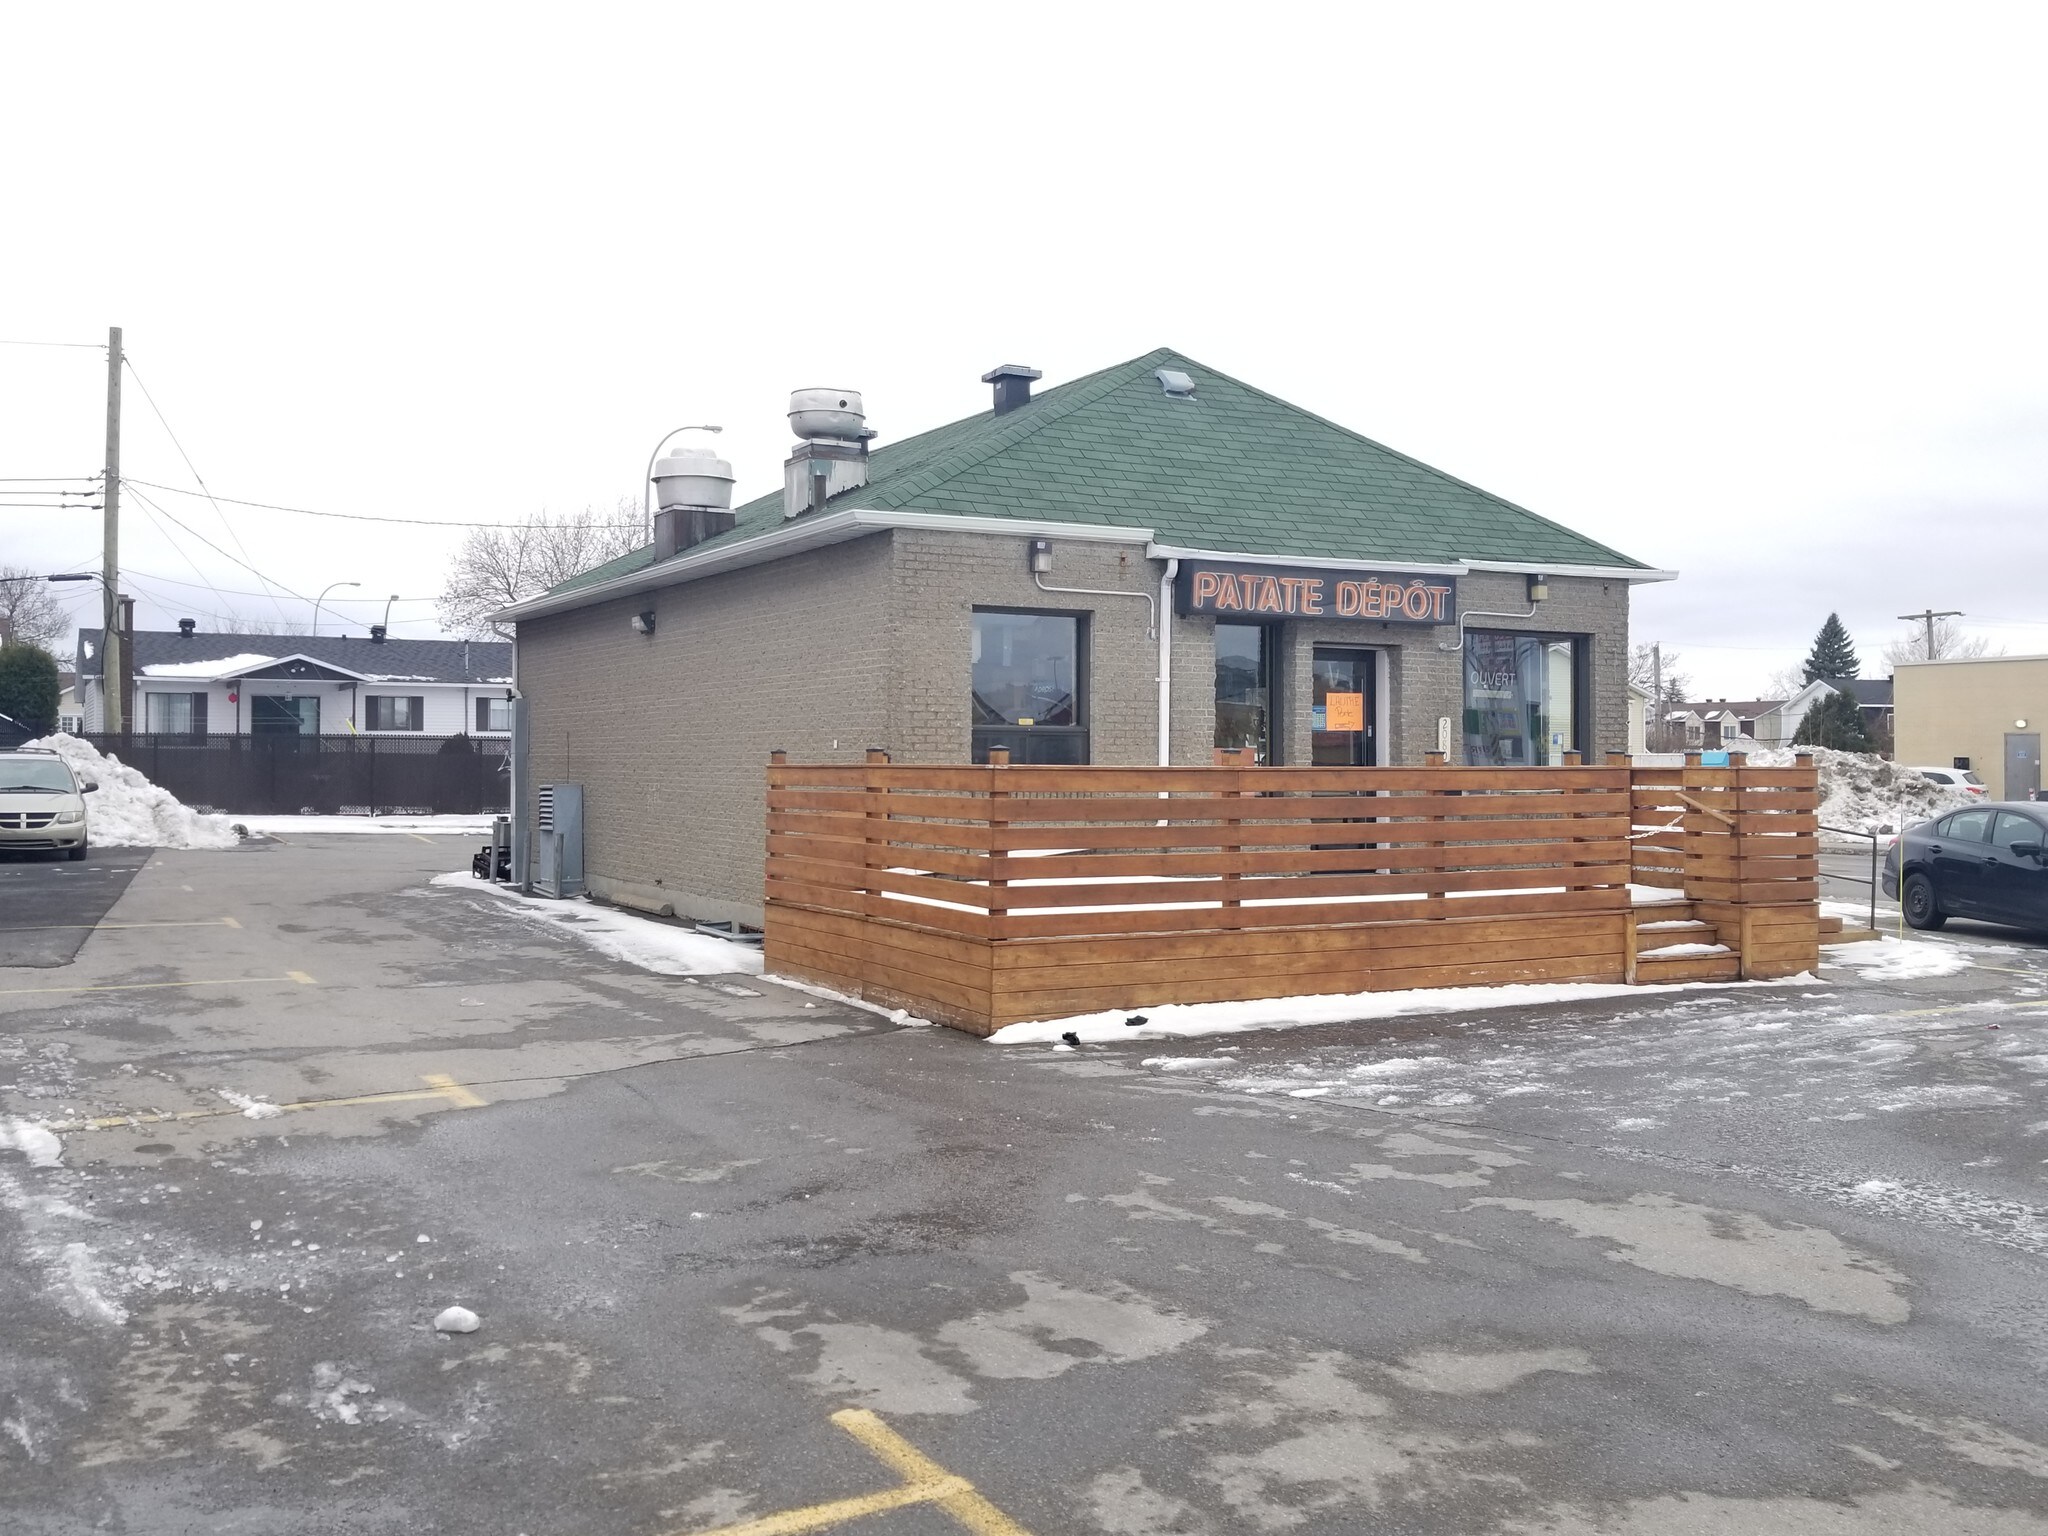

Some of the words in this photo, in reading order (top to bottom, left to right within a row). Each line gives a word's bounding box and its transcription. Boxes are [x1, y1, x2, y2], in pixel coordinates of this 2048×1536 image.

[1193, 571, 1324, 615] PATATE
[1335, 577, 1451, 620] DÉPÔT
[1470, 671, 1516, 686] OUVERT
